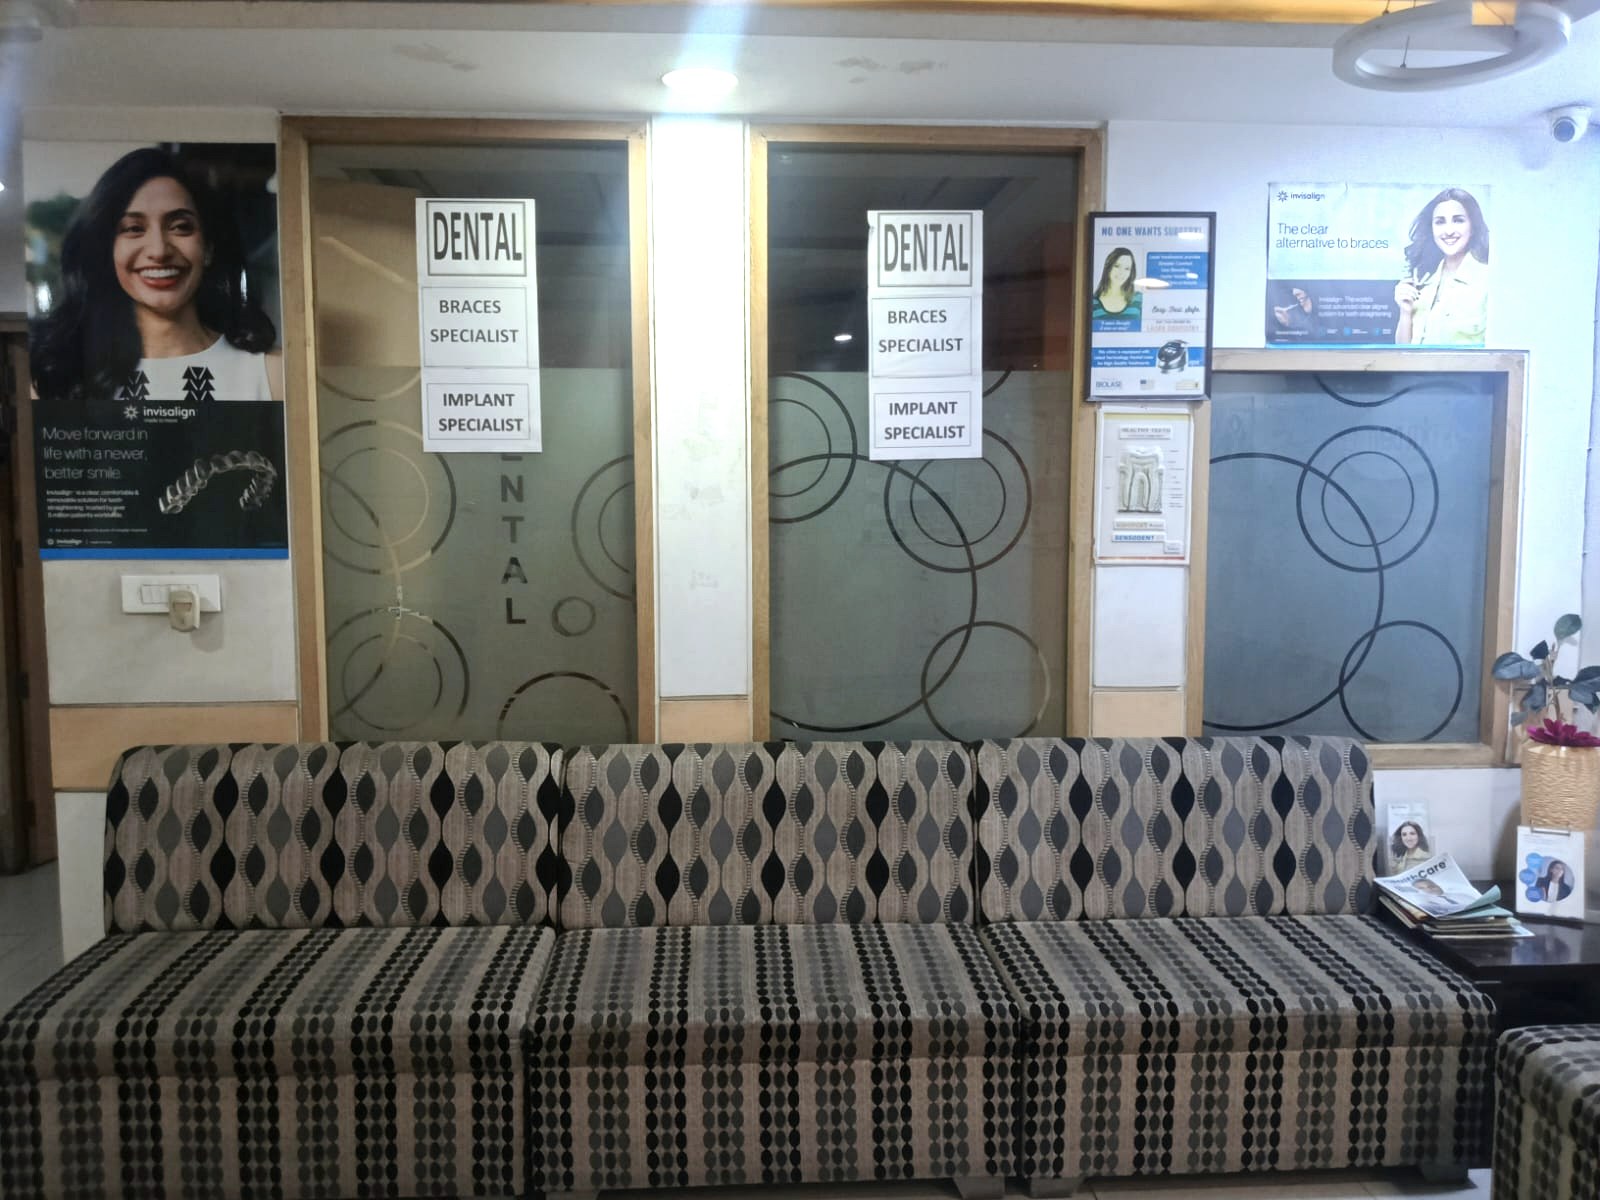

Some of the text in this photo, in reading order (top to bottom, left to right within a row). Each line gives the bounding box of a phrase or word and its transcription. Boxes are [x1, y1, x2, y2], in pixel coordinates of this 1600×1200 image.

[1291, 192, 1325, 201] invisalign
[1101, 226, 1113, 236] NO
[1116, 226, 1132, 236] ONE
[1135, 226, 1161, 236] WANTS
[1277, 223, 1328, 234] The clear
[433, 212, 522, 260] DENTAL
[1276, 237, 1389, 248] alternative to braces
[884, 223, 968, 271] DENTAL
[439, 300, 501, 313] BRACES
[887, 309, 947, 323] BRACES
[430, 329, 518, 342] SPECIALIST
[878, 338, 963, 352] SPECIALIST
[443, 393, 515, 406] IMPLANT
[143, 406, 195, 419] invisalign
[889, 401, 957, 415] IMPLANT
[438, 418, 523, 431] SPECIALIST
[42, 427, 148, 440] Move forward in
[884, 425, 965, 440] SPECIALIST
[43, 447, 62, 460] life
[64, 447, 91, 460] with
[93, 450, 102, 460] a
[45, 467, 84, 479] better
[501, 453, 528, 624] NTAL
